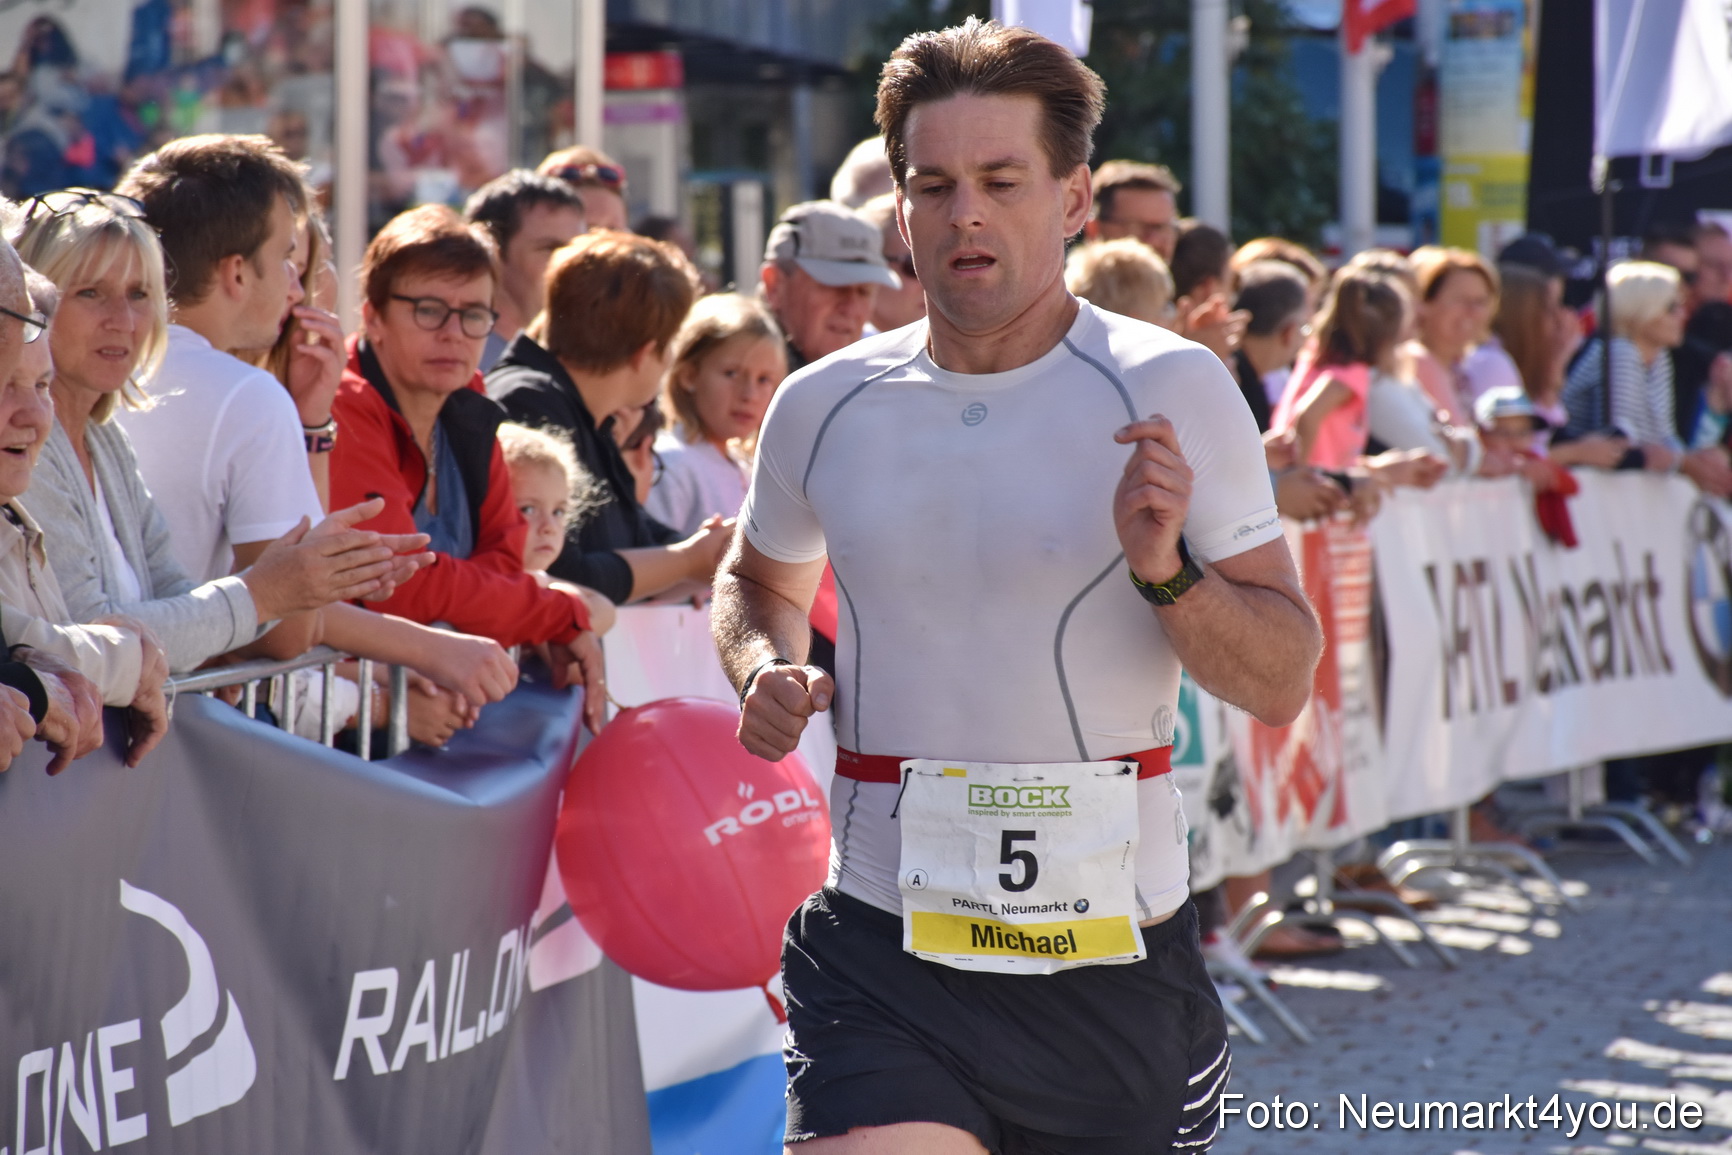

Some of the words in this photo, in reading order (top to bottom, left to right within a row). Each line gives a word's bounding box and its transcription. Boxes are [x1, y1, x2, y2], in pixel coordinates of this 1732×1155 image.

[1508, 540, 1674, 696] Nearkt
[703, 781, 820, 847] RÖDL
[968, 784, 1072, 808] BOCK
[968, 808, 999, 818] inspired
[1000, 809, 1010, 818] by
[1012, 810, 1036, 818] smart
[1037, 809, 1072, 818] concepts
[998, 829, 1039, 893] 5
[952, 898, 998, 915] PARTL
[1001, 901, 1068, 916] Neumarkt
[971, 923, 1078, 956] Michael
[333, 909, 537, 1081] RAIL.ON
